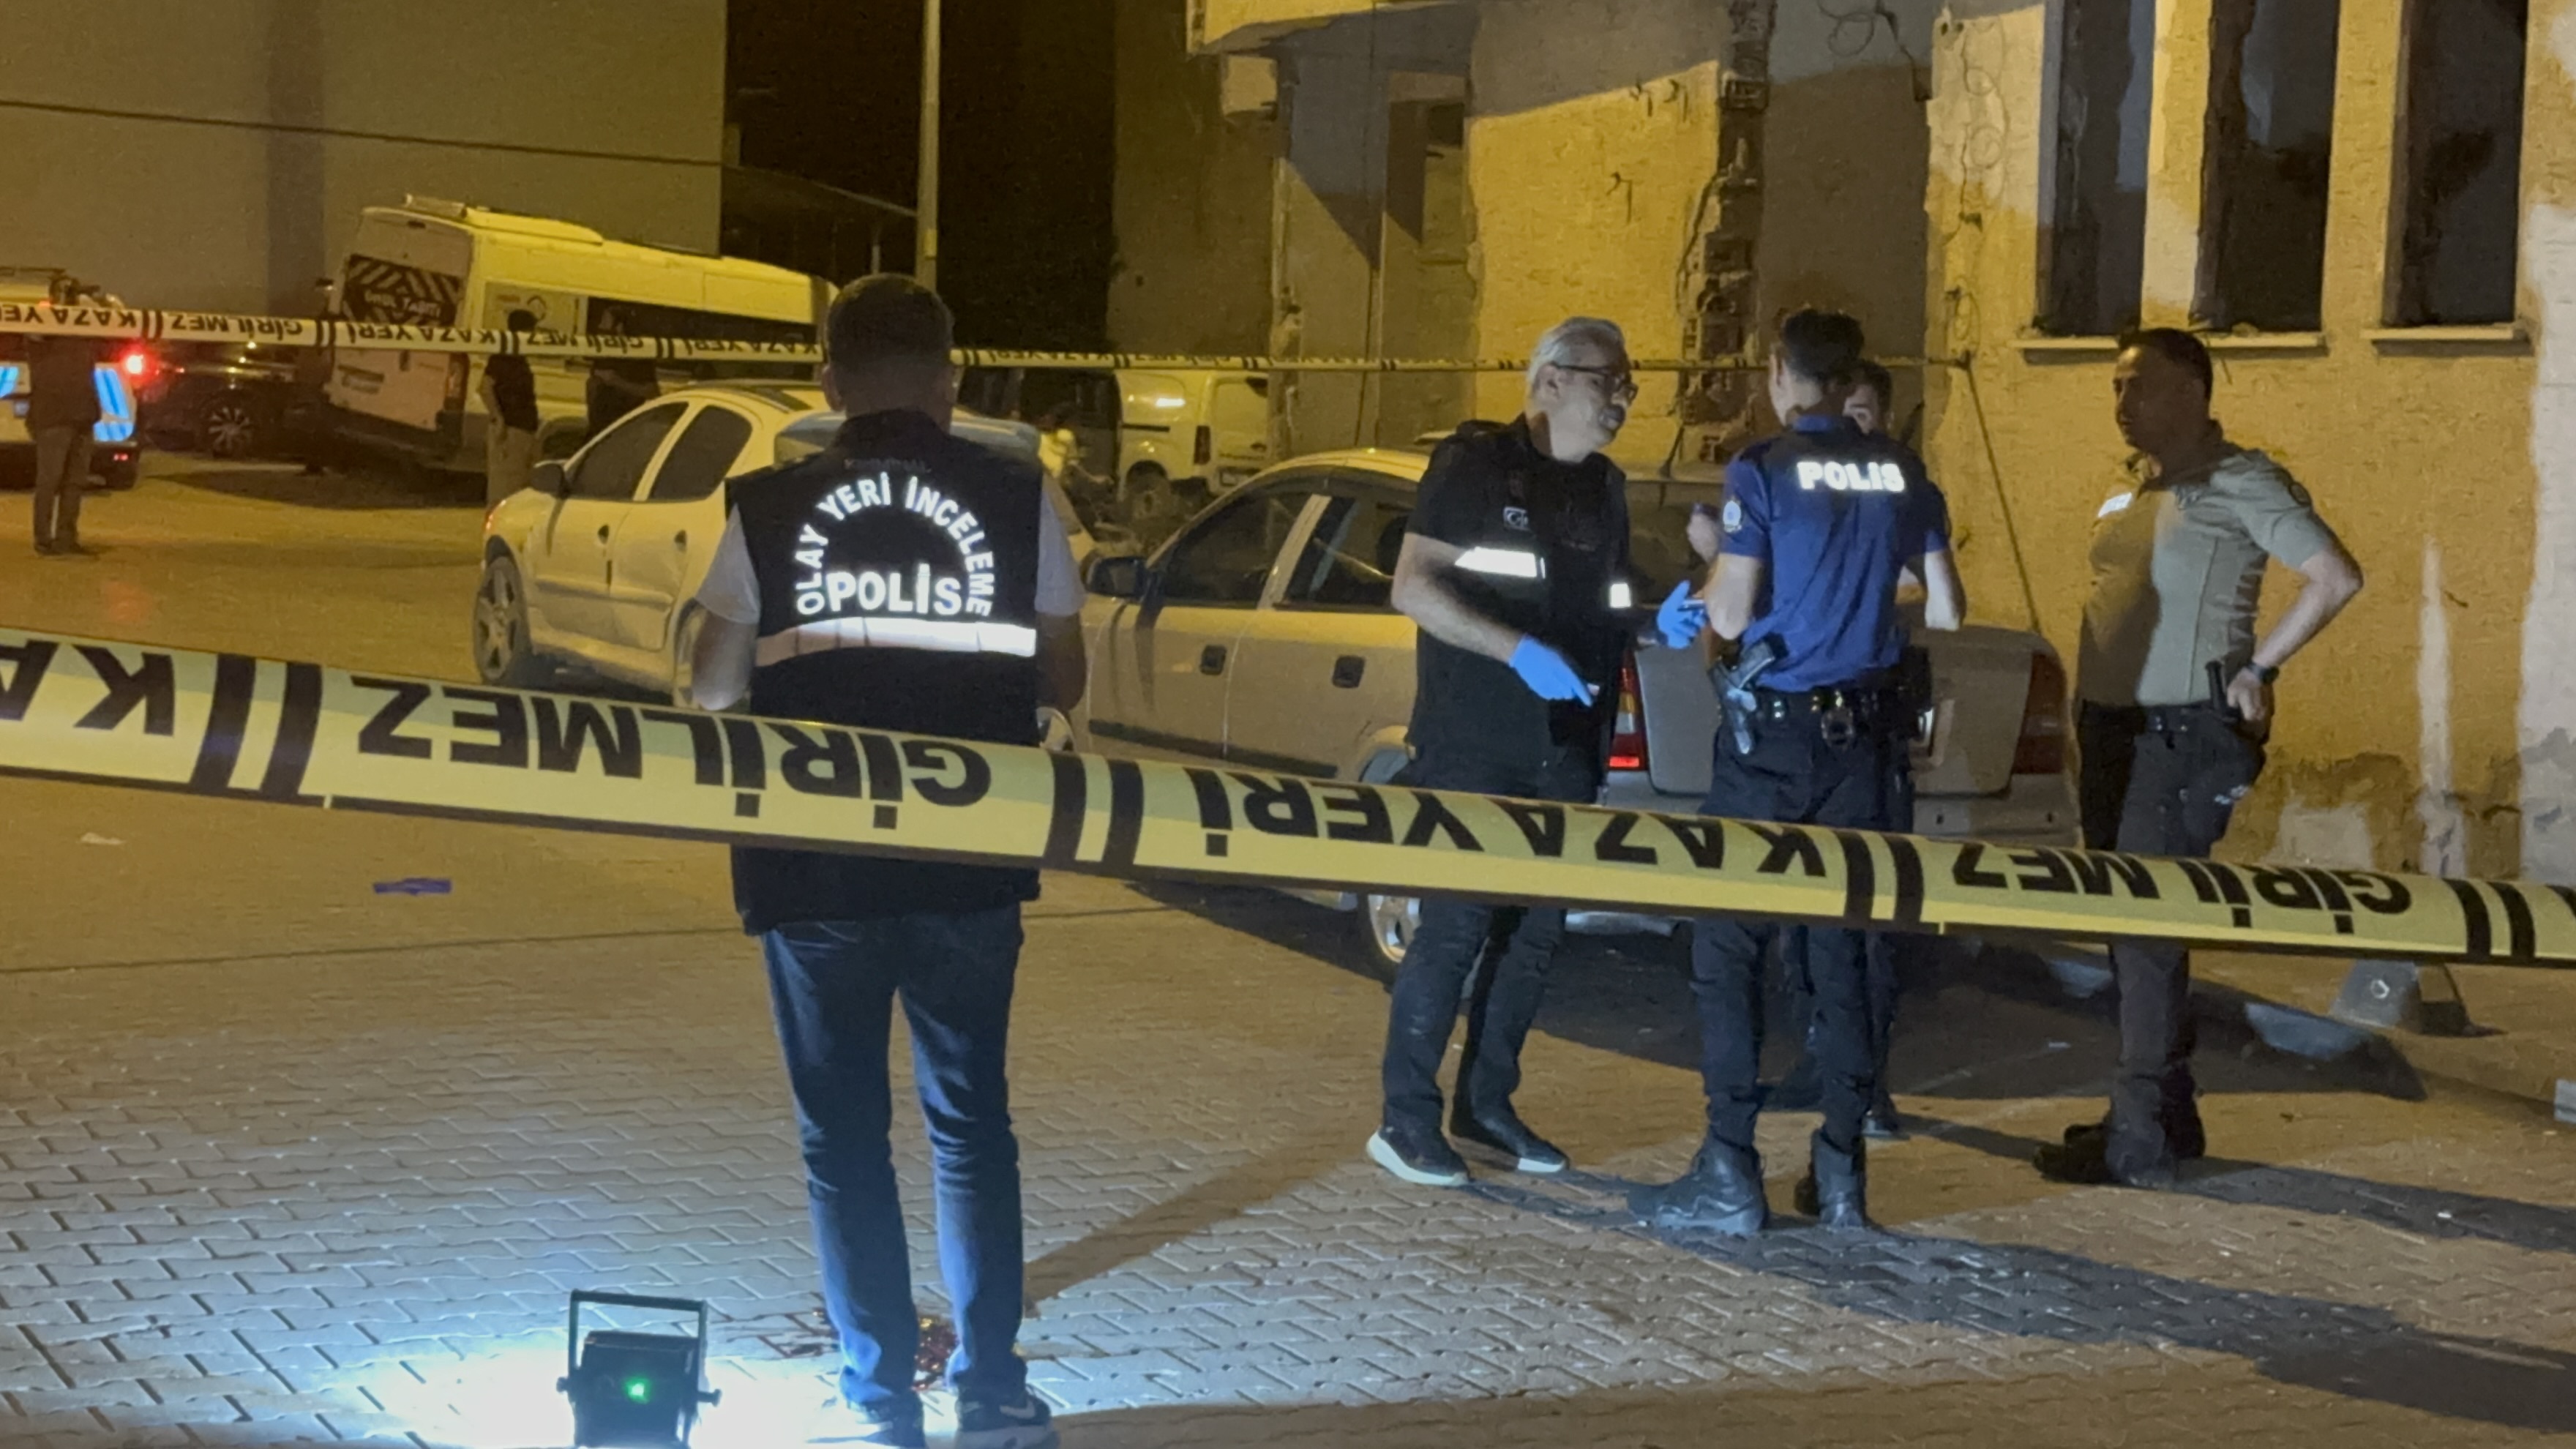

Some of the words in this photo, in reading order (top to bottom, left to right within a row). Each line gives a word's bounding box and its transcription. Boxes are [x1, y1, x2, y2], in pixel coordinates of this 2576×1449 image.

[0, 304, 44, 323] YE
[50, 307, 137, 327] KAZA
[346, 322, 413, 344] YERİ
[417, 328, 495, 345] KAZA
[795, 524, 829, 615] OLAY
[815, 471, 891, 521] YERİ
[825, 563, 962, 616] POLİS
[350, 675, 992, 831] GİRİLMEZ
[1183, 766, 1485, 857] YERİ
[1483, 795, 1827, 878] KAZA
[1952, 843, 2414, 935] GİRİLMEZ
